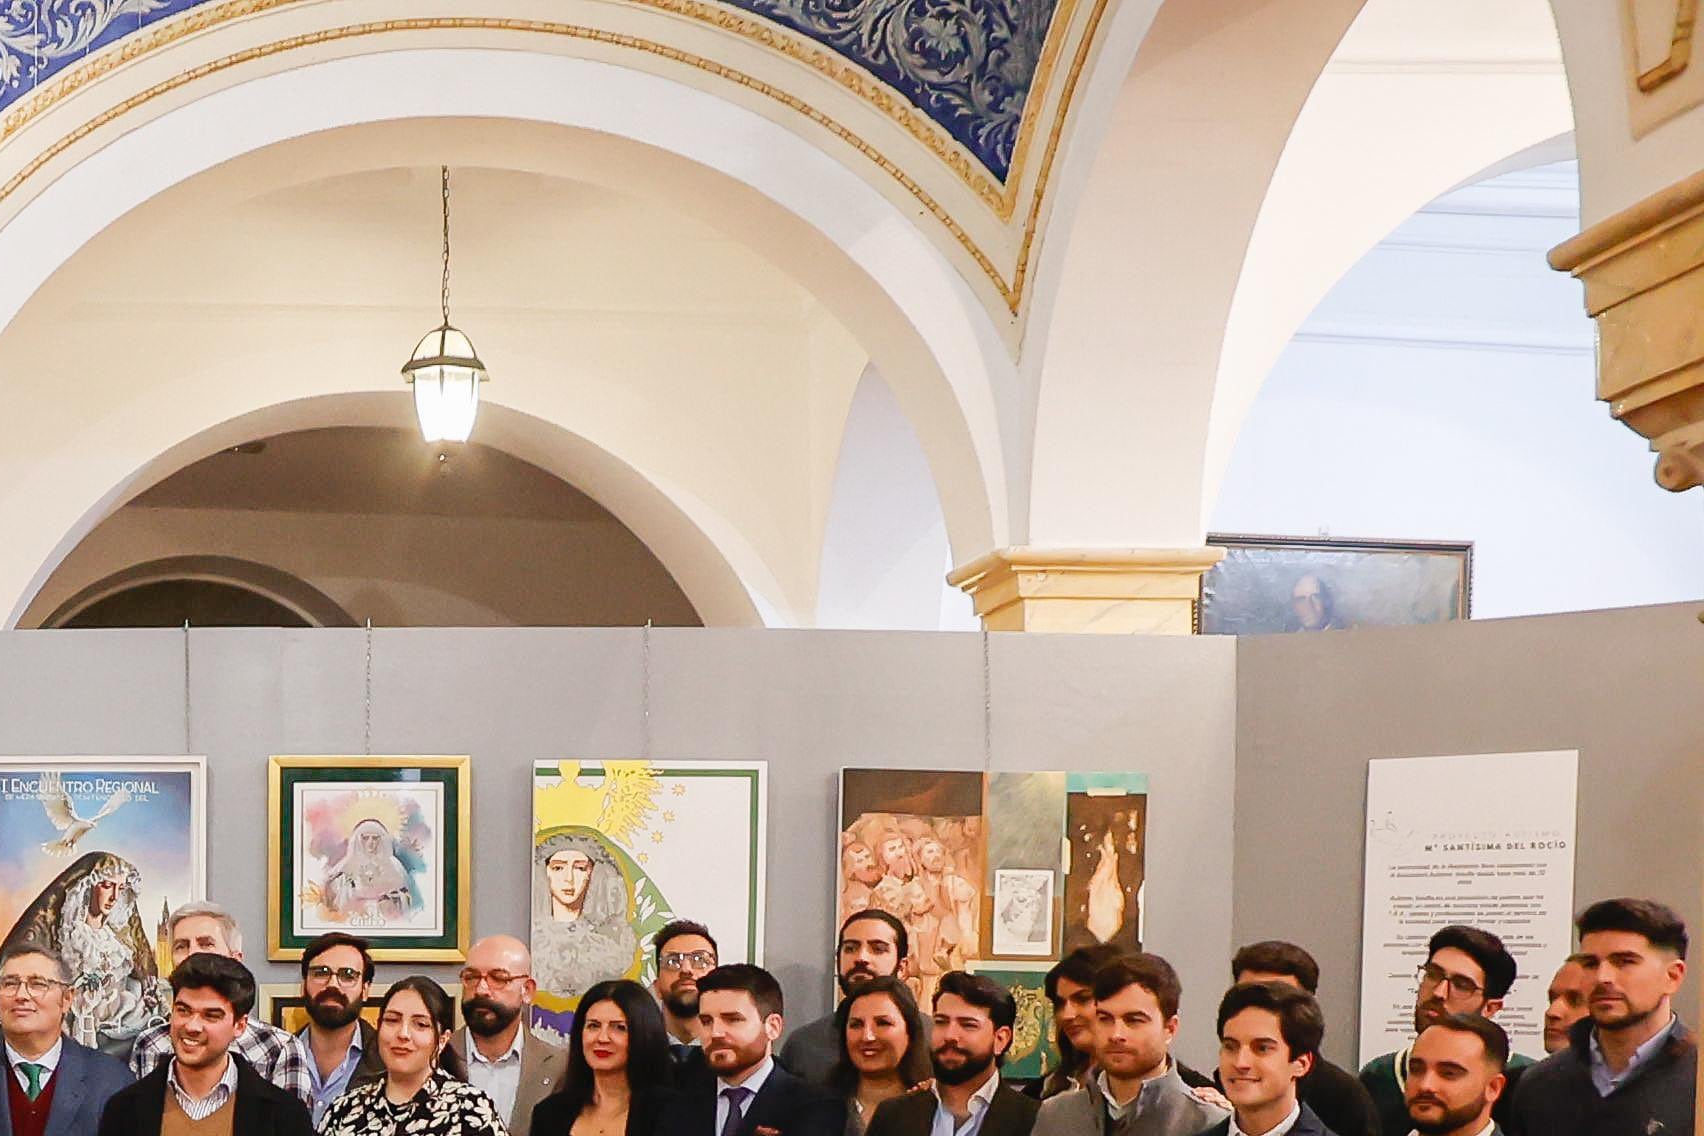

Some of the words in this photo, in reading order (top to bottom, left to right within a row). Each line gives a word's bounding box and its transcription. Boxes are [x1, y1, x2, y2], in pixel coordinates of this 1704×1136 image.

[95, 777, 160, 795] REGIONAL
[1442, 842, 1502, 852] SANTÍSIMA
[1506, 841, 1526, 850] DEL
[1529, 839, 1567, 850] ROCÍO
